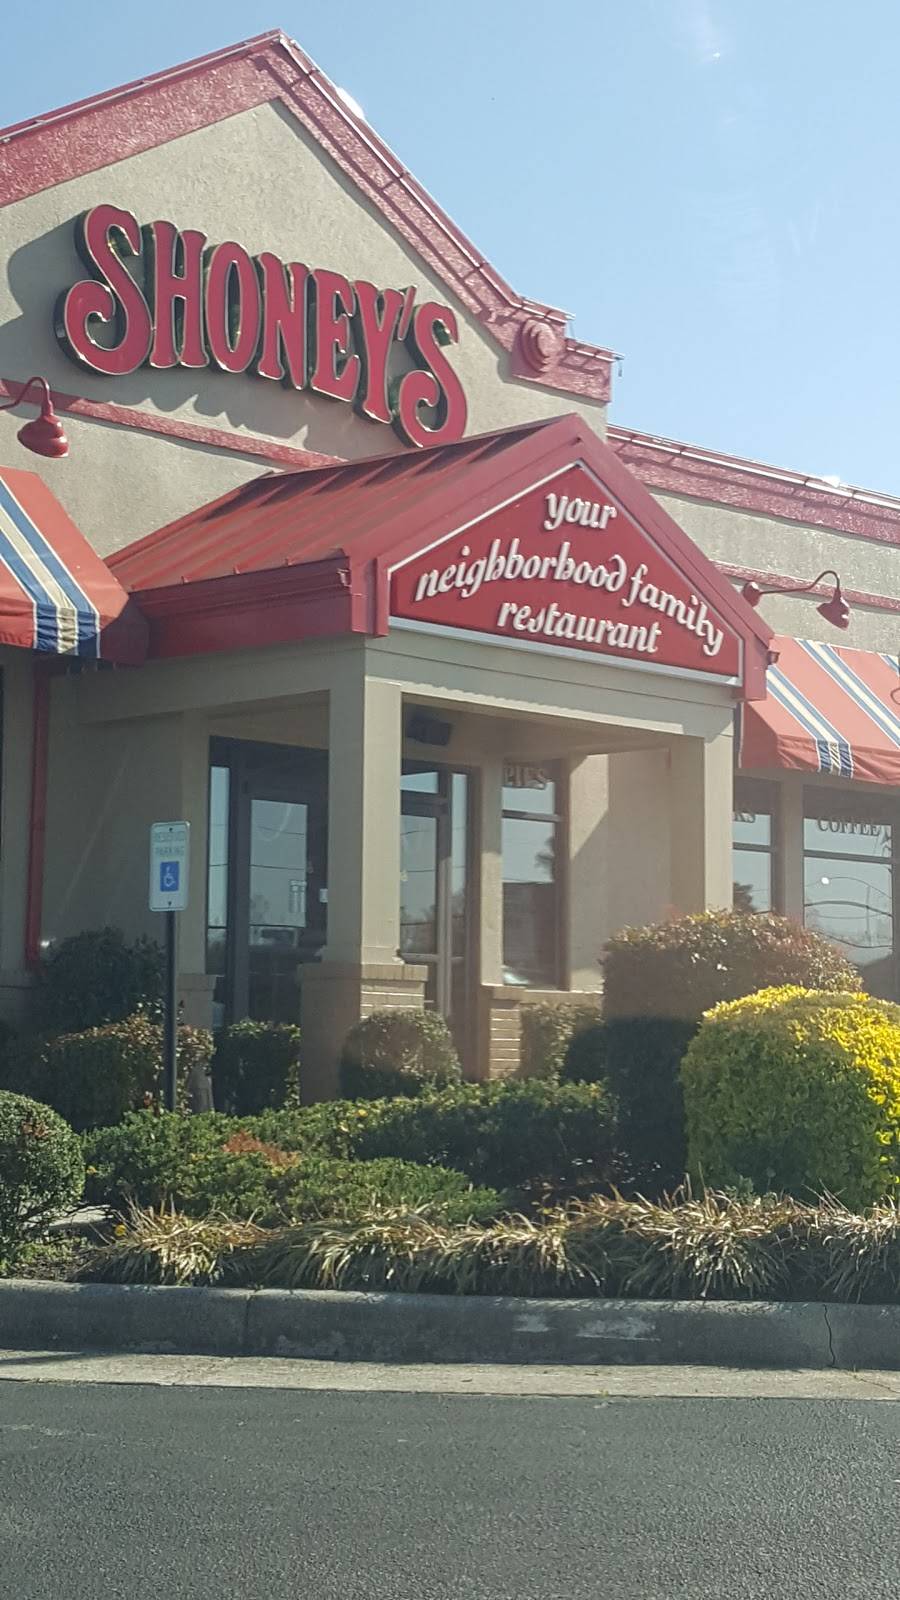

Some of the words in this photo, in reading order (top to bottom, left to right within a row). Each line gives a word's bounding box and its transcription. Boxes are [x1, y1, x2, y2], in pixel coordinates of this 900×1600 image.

[58, 203, 467, 448] SHONEY'S
[544, 492, 618, 531] your
[414, 538, 628, 602] neighborhood
[621, 563, 725, 657] family
[496, 600, 663, 654] restaurant
[817, 816, 881, 837] COFFEE
